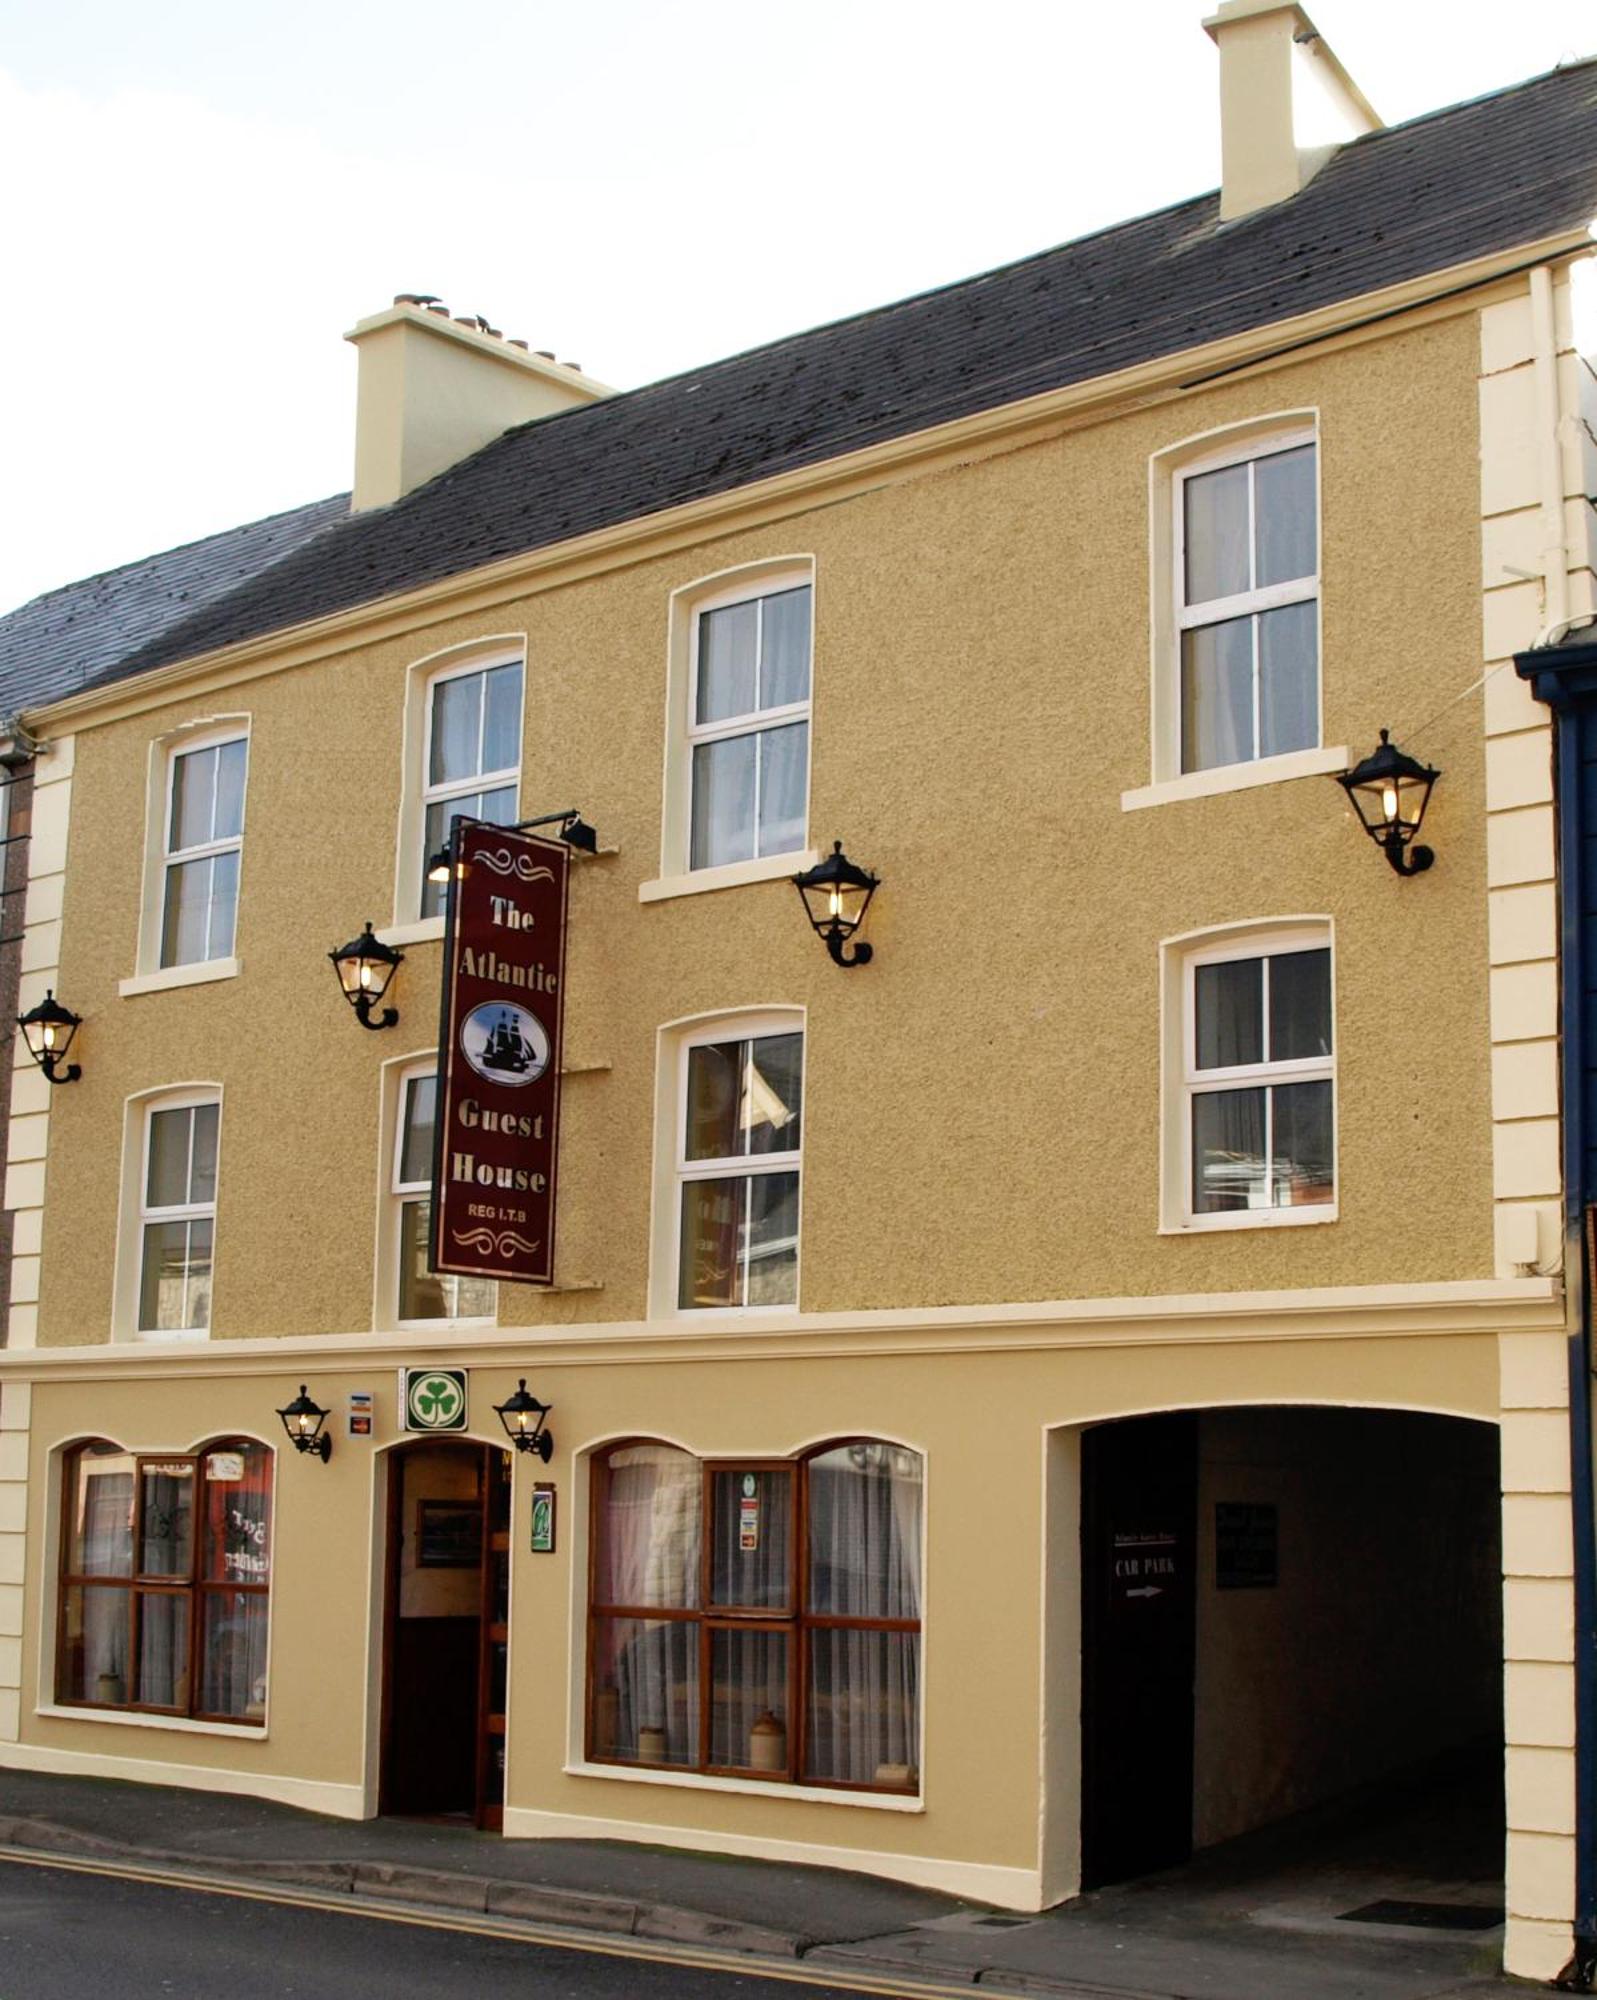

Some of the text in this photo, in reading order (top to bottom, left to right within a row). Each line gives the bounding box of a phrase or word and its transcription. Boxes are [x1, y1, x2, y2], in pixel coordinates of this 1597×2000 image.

[490, 895, 535, 933] The
[459, 946, 557, 994] Atlantic
[458, 1098, 545, 1139] Guest
[452, 1151, 546, 1193] House
[468, 1203, 496, 1219] REG
[1115, 1556, 1175, 1577] CAR PARK
